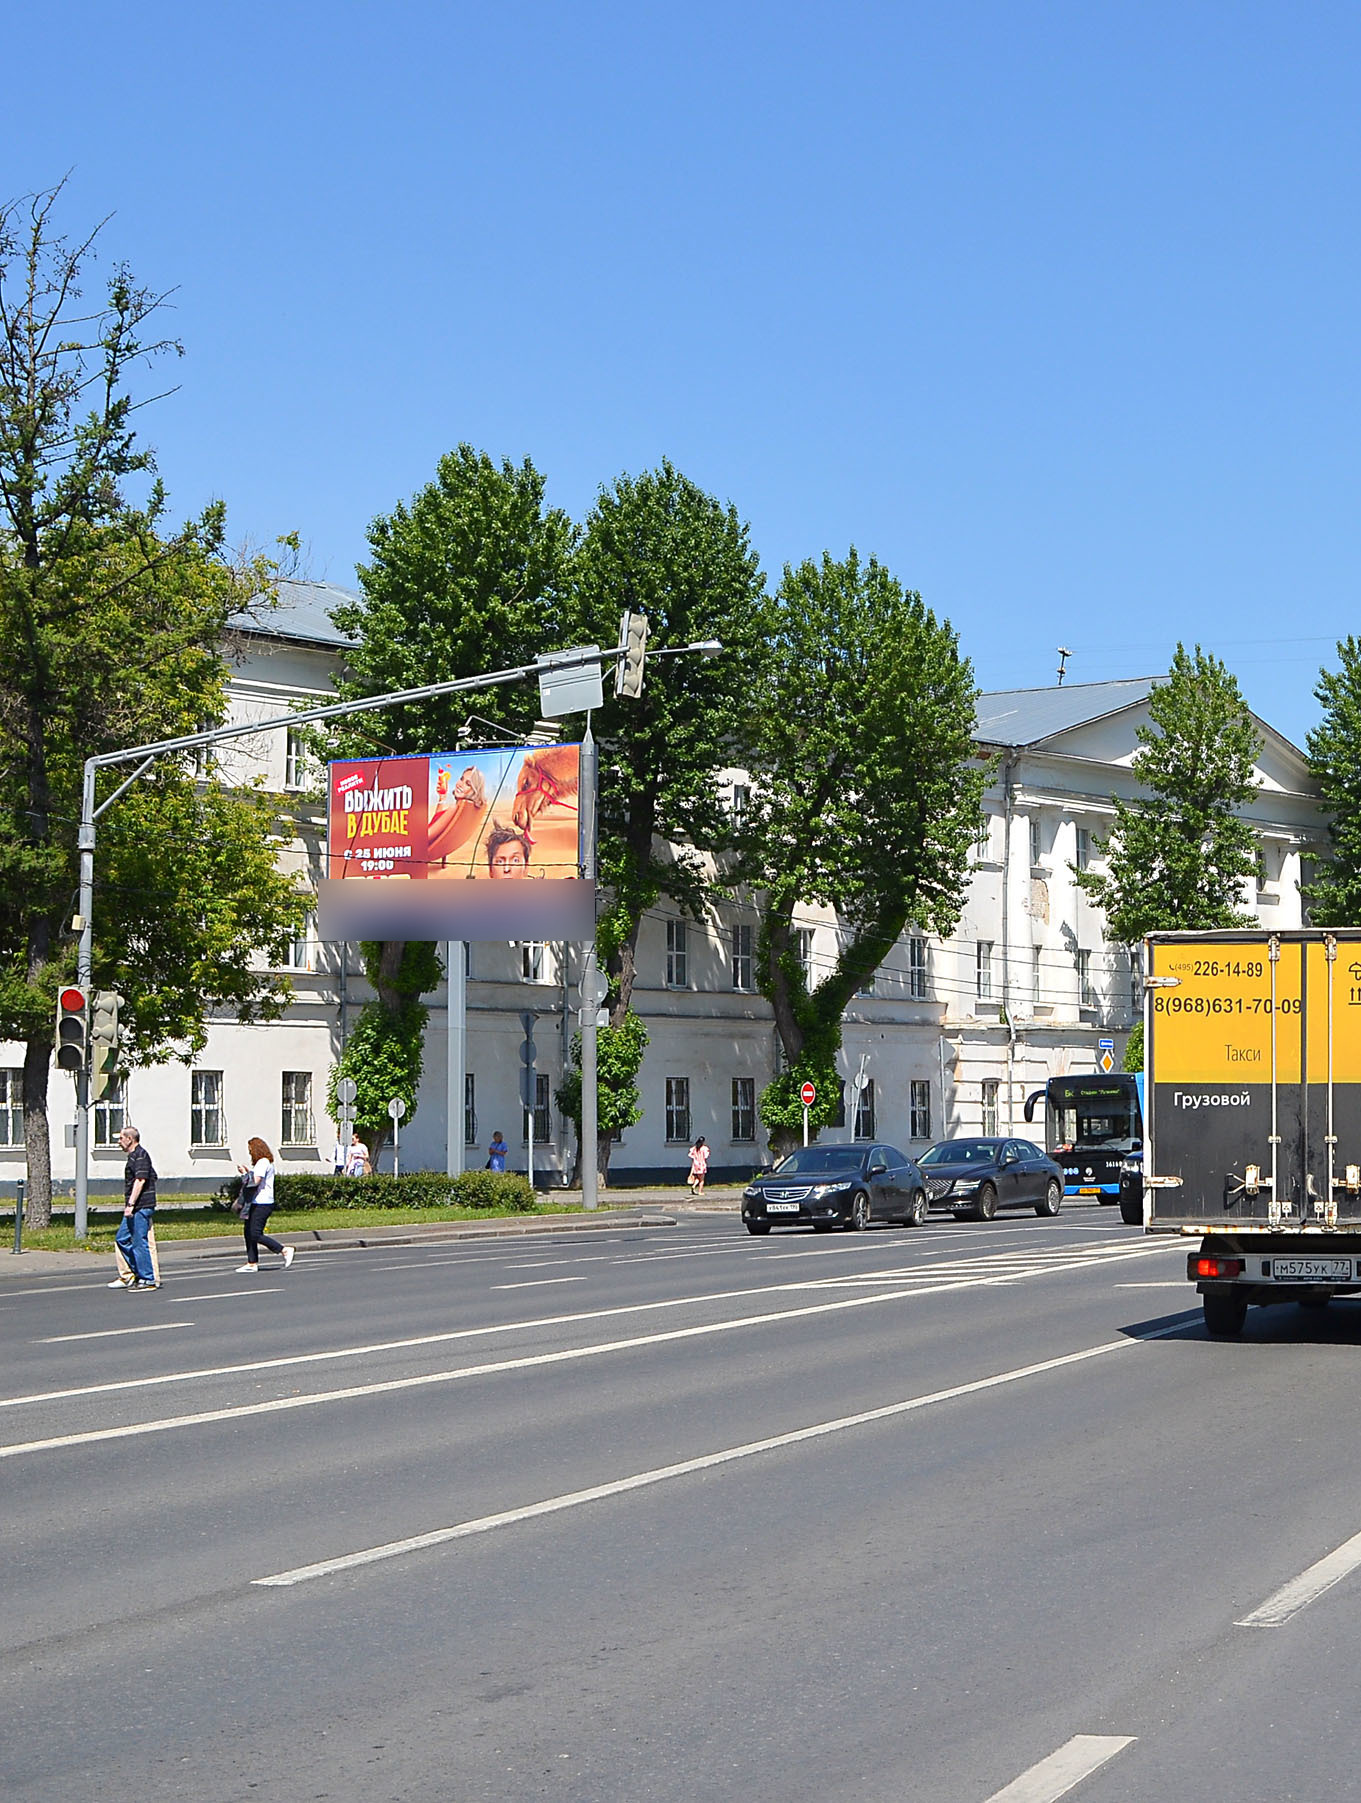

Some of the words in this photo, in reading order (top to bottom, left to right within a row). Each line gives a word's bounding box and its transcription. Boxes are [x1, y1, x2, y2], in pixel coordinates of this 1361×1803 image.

[344, 778, 413, 813] ВЫЖИТЬ
[347, 813, 357, 839] В
[360, 810, 409, 838] ДУБАЕ
[343, 849, 353, 860] С
[373, 845, 412, 859] ИЮНЯ
[360, 859, 394, 871] 19:00
[1154, 997, 1302, 1016] 8(968)631-70-09
[1224, 1044, 1261, 1062] Такси
[1174, 1091, 1251, 1109] Грузовой
[1280, 1261, 1328, 1274] М575УК
[1333, 1261, 1346, 1271] 77
